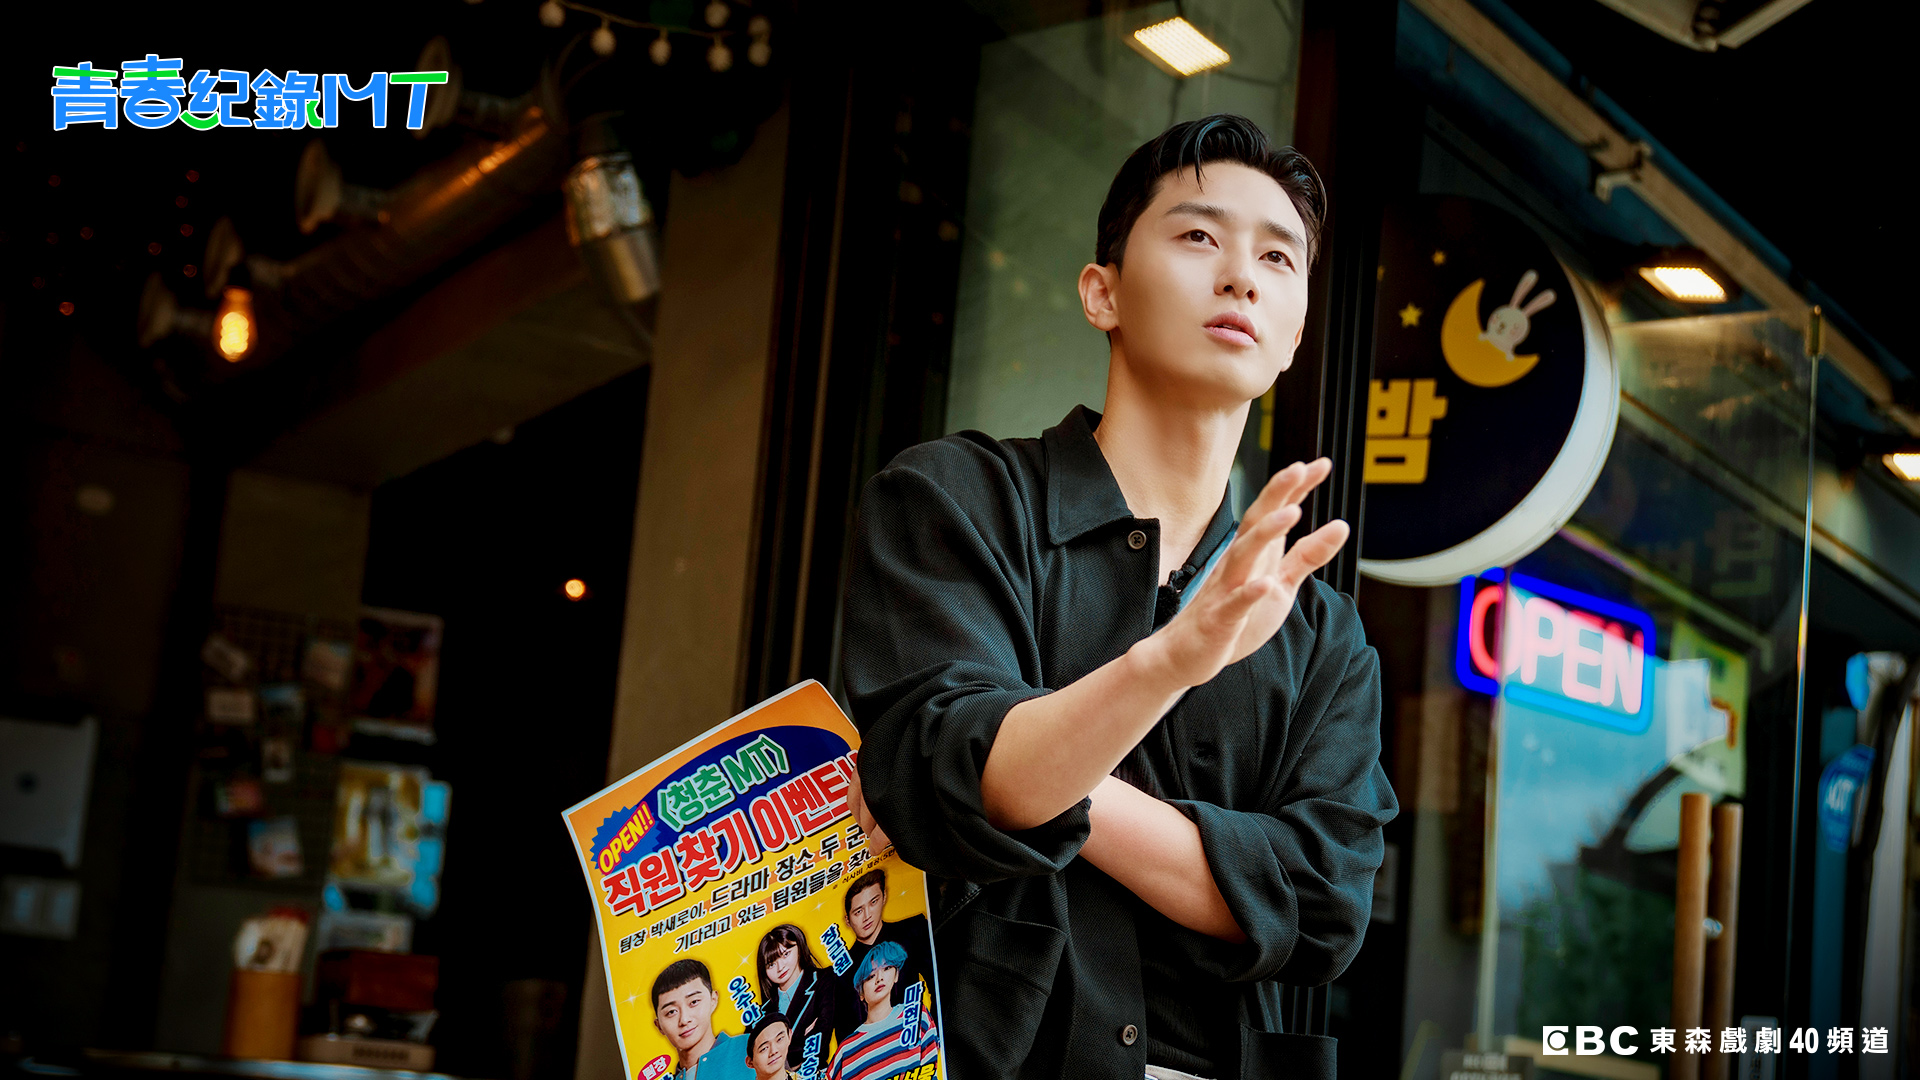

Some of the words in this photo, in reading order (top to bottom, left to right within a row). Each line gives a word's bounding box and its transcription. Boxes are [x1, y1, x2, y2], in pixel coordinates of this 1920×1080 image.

[1469, 584, 1645, 714] OPEN
[598, 801, 655, 875] OPEN!!
[602, 847, 684, 915] 직원
[674, 809, 761, 891] 찾기
[619, 928, 647, 954] 팀장
[651, 901, 706, 938] 박새로이,
[710, 866, 770, 912] 드라마
[776, 848, 814, 883] 장소
[820, 833, 840, 860] 두
[673, 914, 732, 954] 기다리고
[737, 903, 766, 926] 있는
[772, 861, 844, 912] 팀원들을
[820, 923, 853, 976] 장근원
[728, 976, 761, 1026] 오수아
[901, 981, 923, 1046] 마현이
[642, 1056, 667, 1080] 팀장
[801, 1032, 822, 1080] 최승
